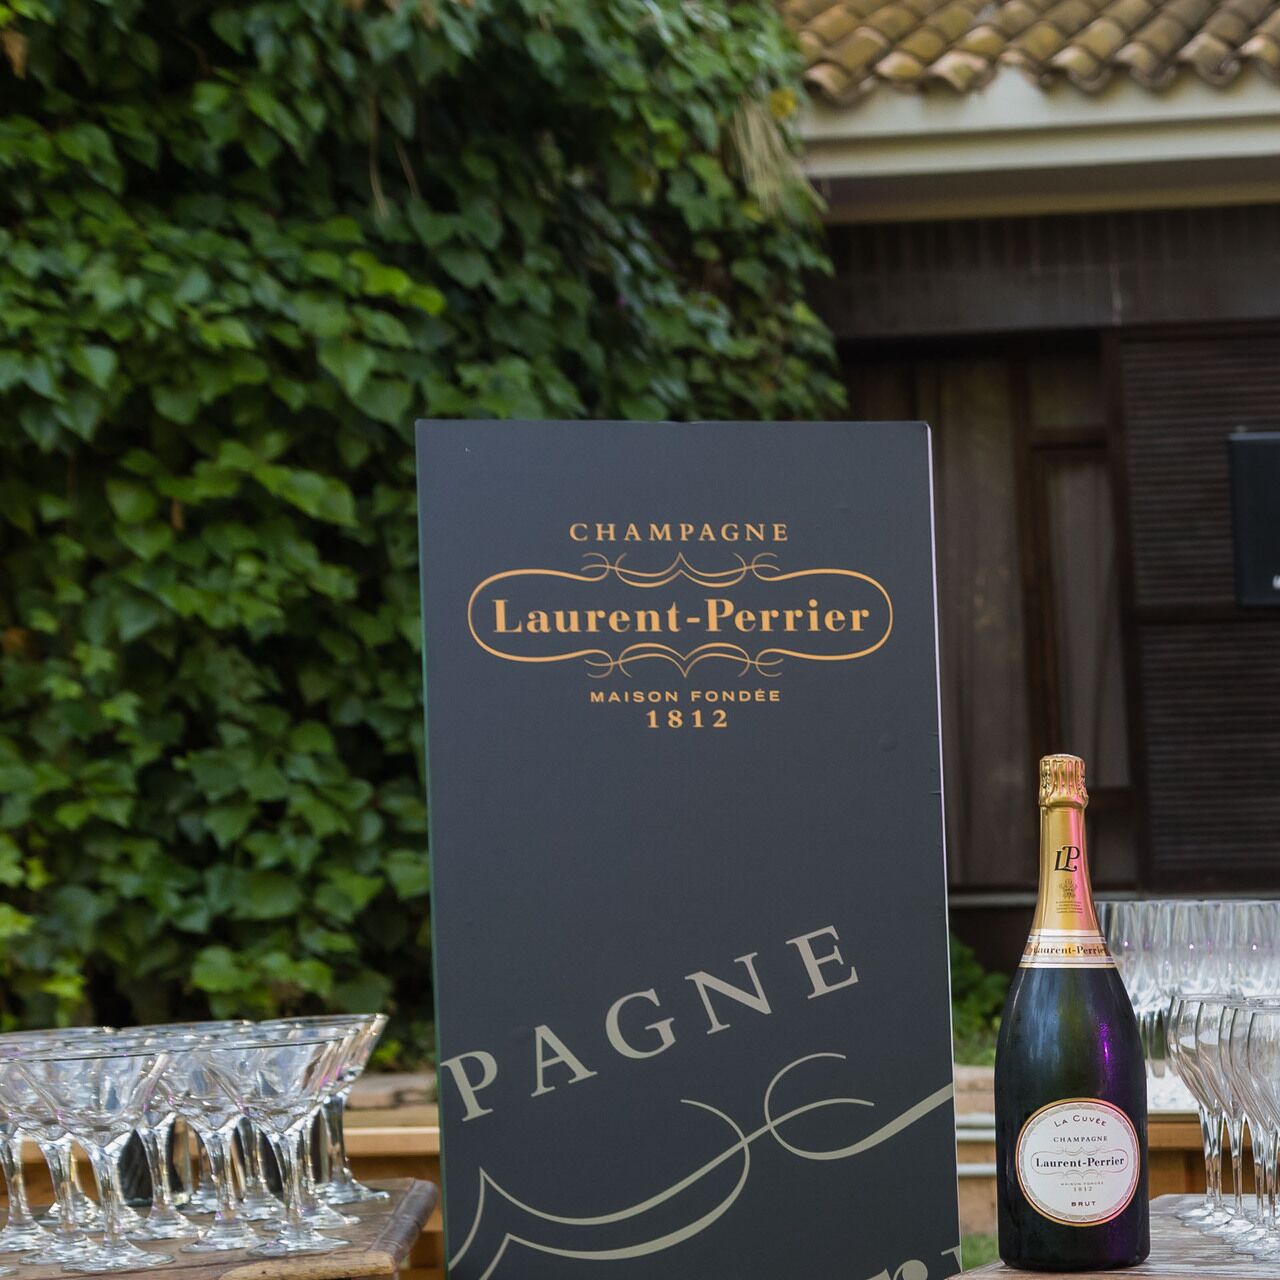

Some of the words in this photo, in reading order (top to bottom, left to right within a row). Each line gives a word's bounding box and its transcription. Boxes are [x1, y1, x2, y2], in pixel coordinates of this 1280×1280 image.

[569, 523, 789, 542] CHAMPAGNE
[493, 598, 870, 633] Laurent-Perrier
[590, 690, 679, 702] MAISON
[691, 687, 781, 701] FONDÉE
[646, 708, 728, 728] 1812
[1053, 1135, 1108, 1143] CHAMPAGNE
[1035, 1156, 1125, 1168] Laurent-Perrier
